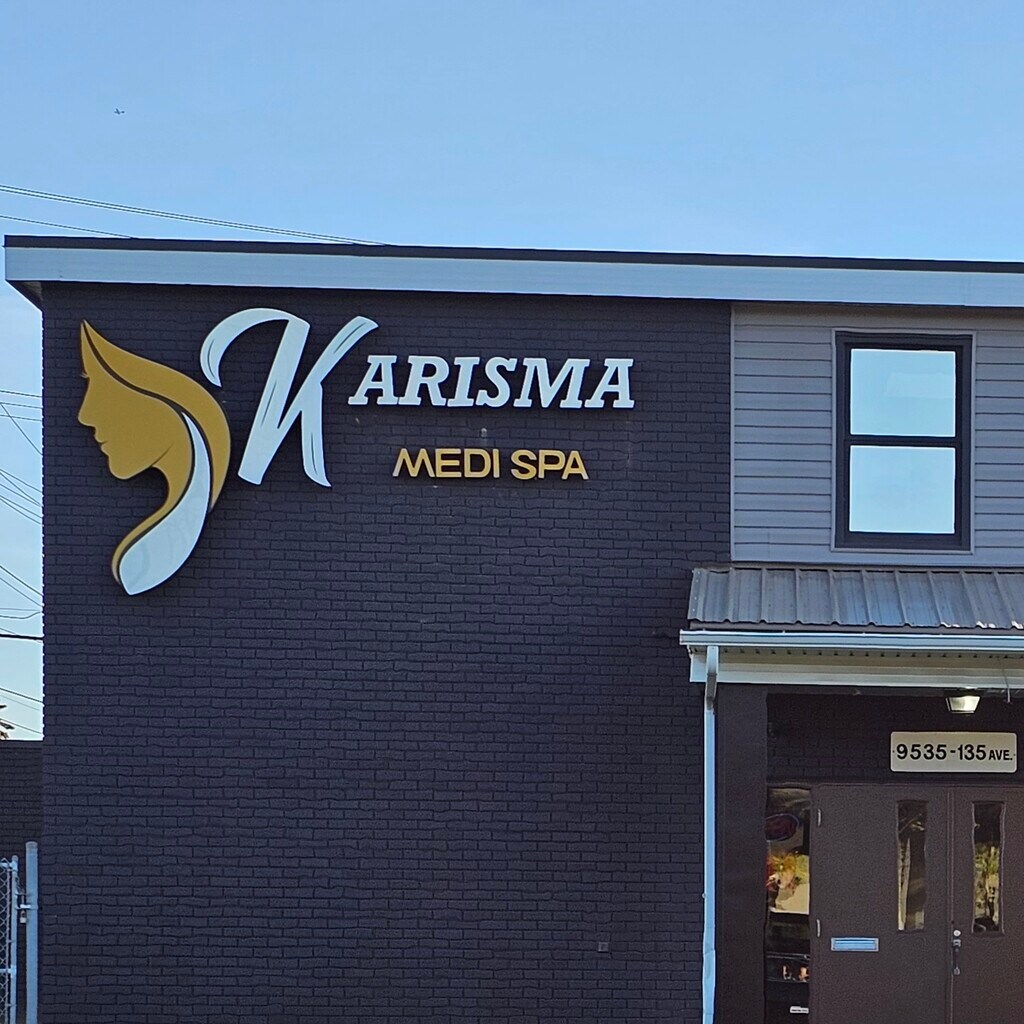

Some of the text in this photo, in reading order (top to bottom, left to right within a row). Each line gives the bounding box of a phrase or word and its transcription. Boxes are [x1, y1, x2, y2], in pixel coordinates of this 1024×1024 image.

[200, 308, 635, 487] KARISMA
[393, 448, 589, 480] MEDI SPA
